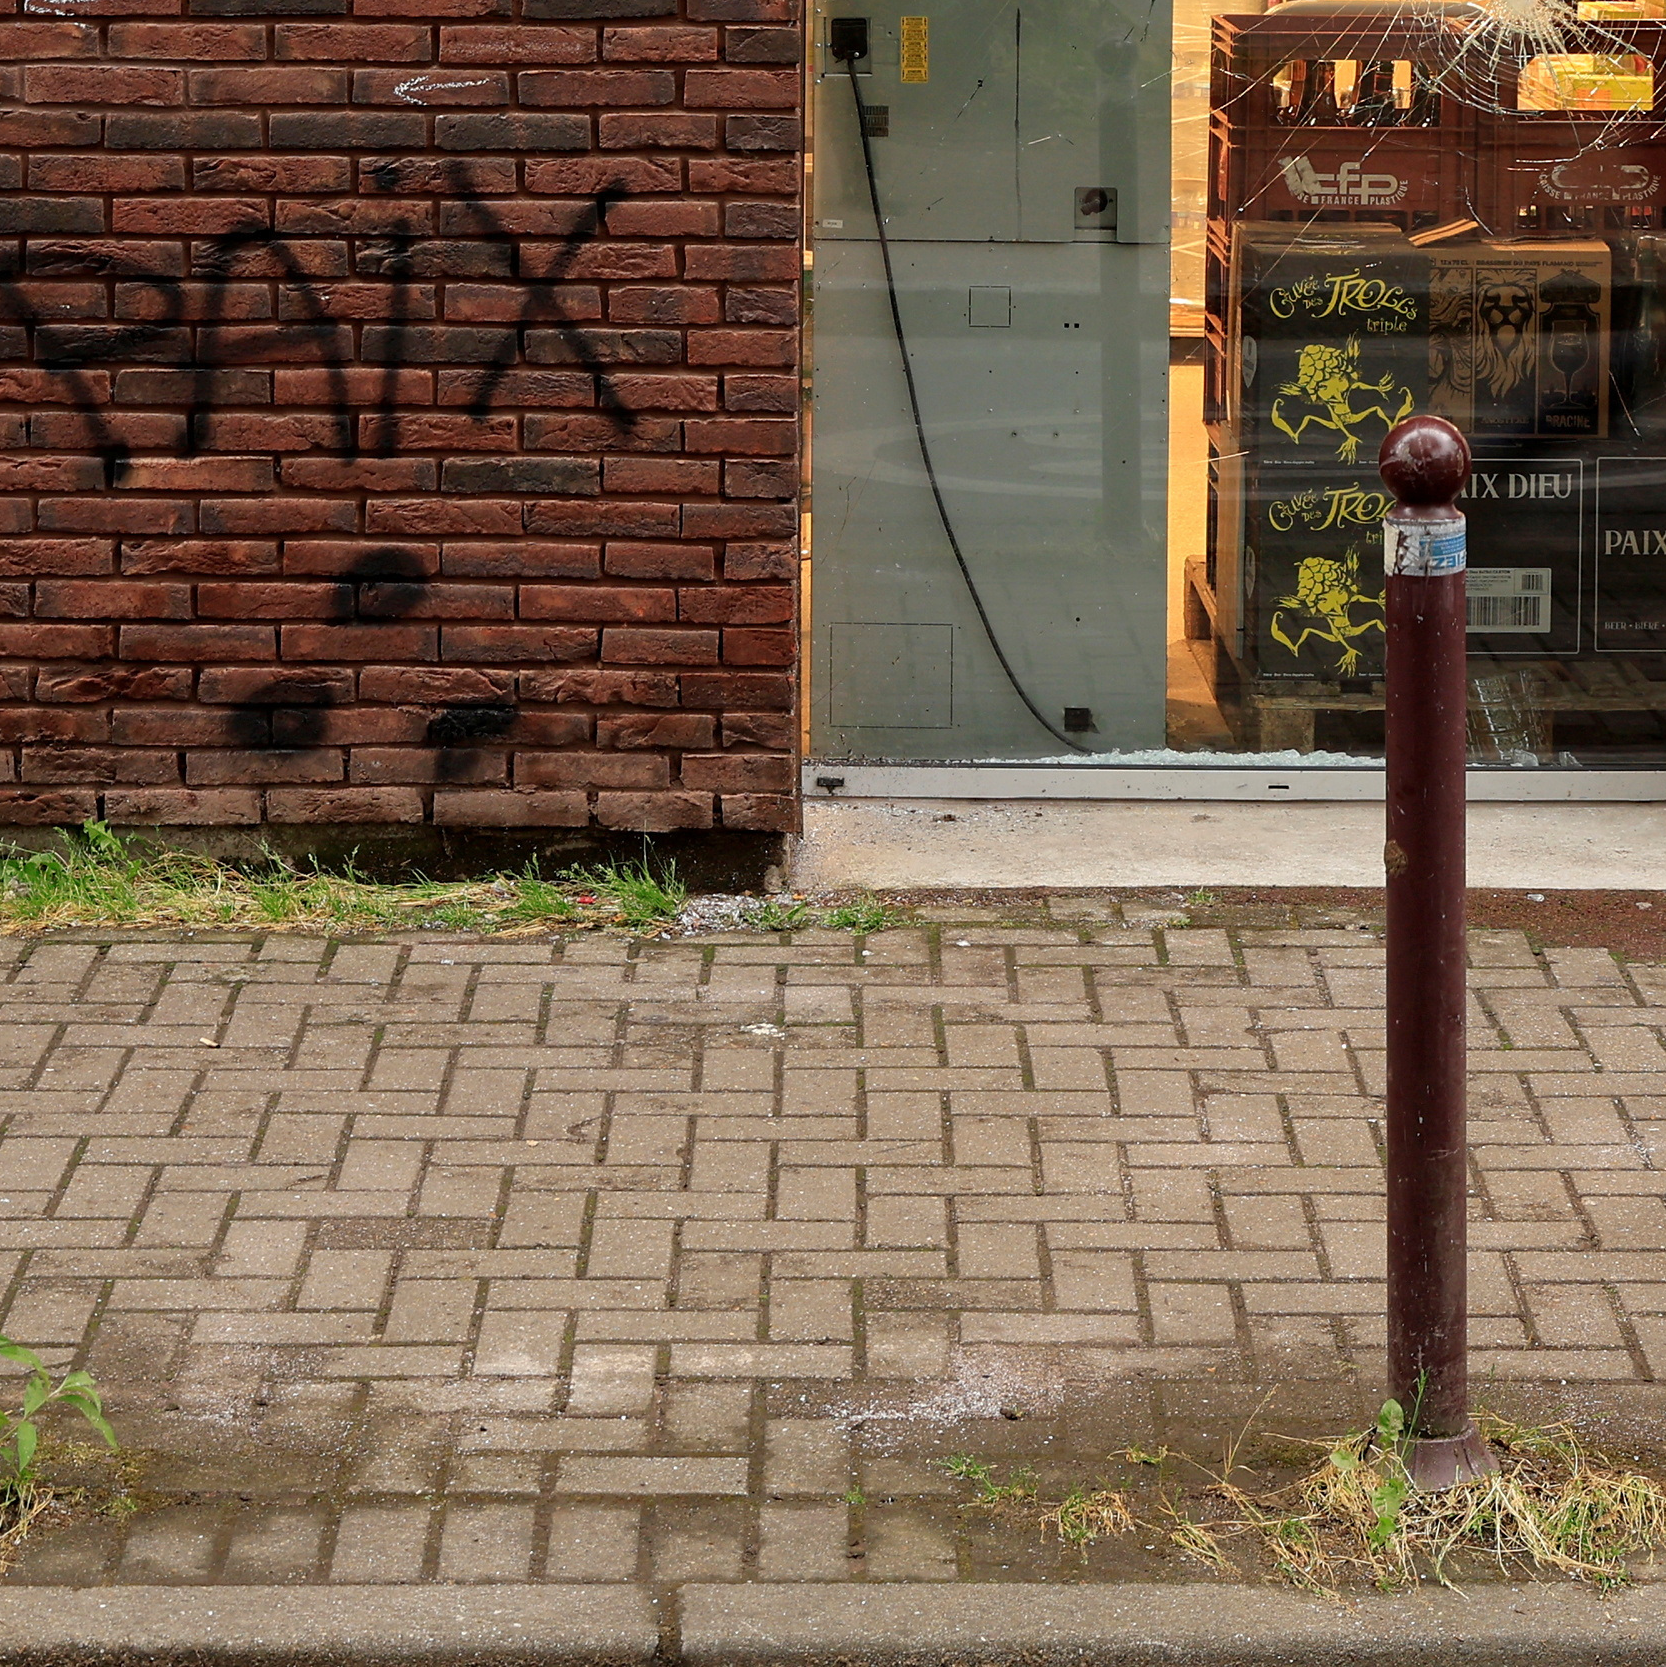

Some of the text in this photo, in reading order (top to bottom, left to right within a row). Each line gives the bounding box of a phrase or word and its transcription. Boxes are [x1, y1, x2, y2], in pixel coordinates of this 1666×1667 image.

[1321, 196, 1360, 205] FRANCE
[1369, 179, 1409, 206] PLASTIQUE
[1366, 316, 1408, 335] triple
[1508, 473, 1574, 499] DIEU
[1365, 531, 1384, 545] tri
[1605, 621, 1627, 630] BEER
